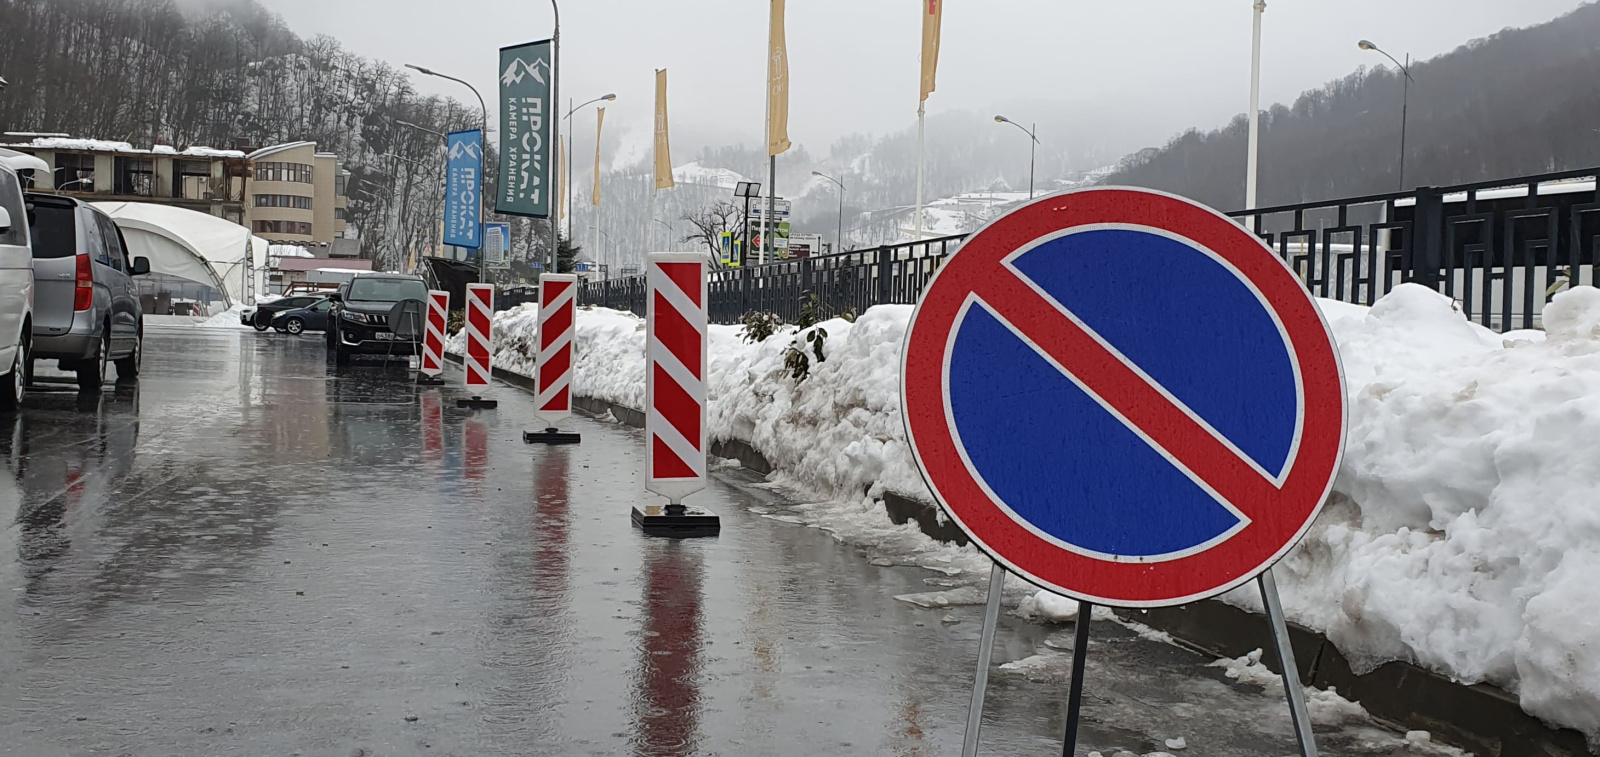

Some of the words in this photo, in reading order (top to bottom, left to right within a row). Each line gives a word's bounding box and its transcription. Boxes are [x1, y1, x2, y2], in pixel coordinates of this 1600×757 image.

[509, 97, 517, 141] КАМЕРА
[519, 97, 542, 204] ПРОКАТ
[459, 168, 475, 239] ПРОКАТ
[506, 147, 517, 202] ХРАНЕНИЯ
